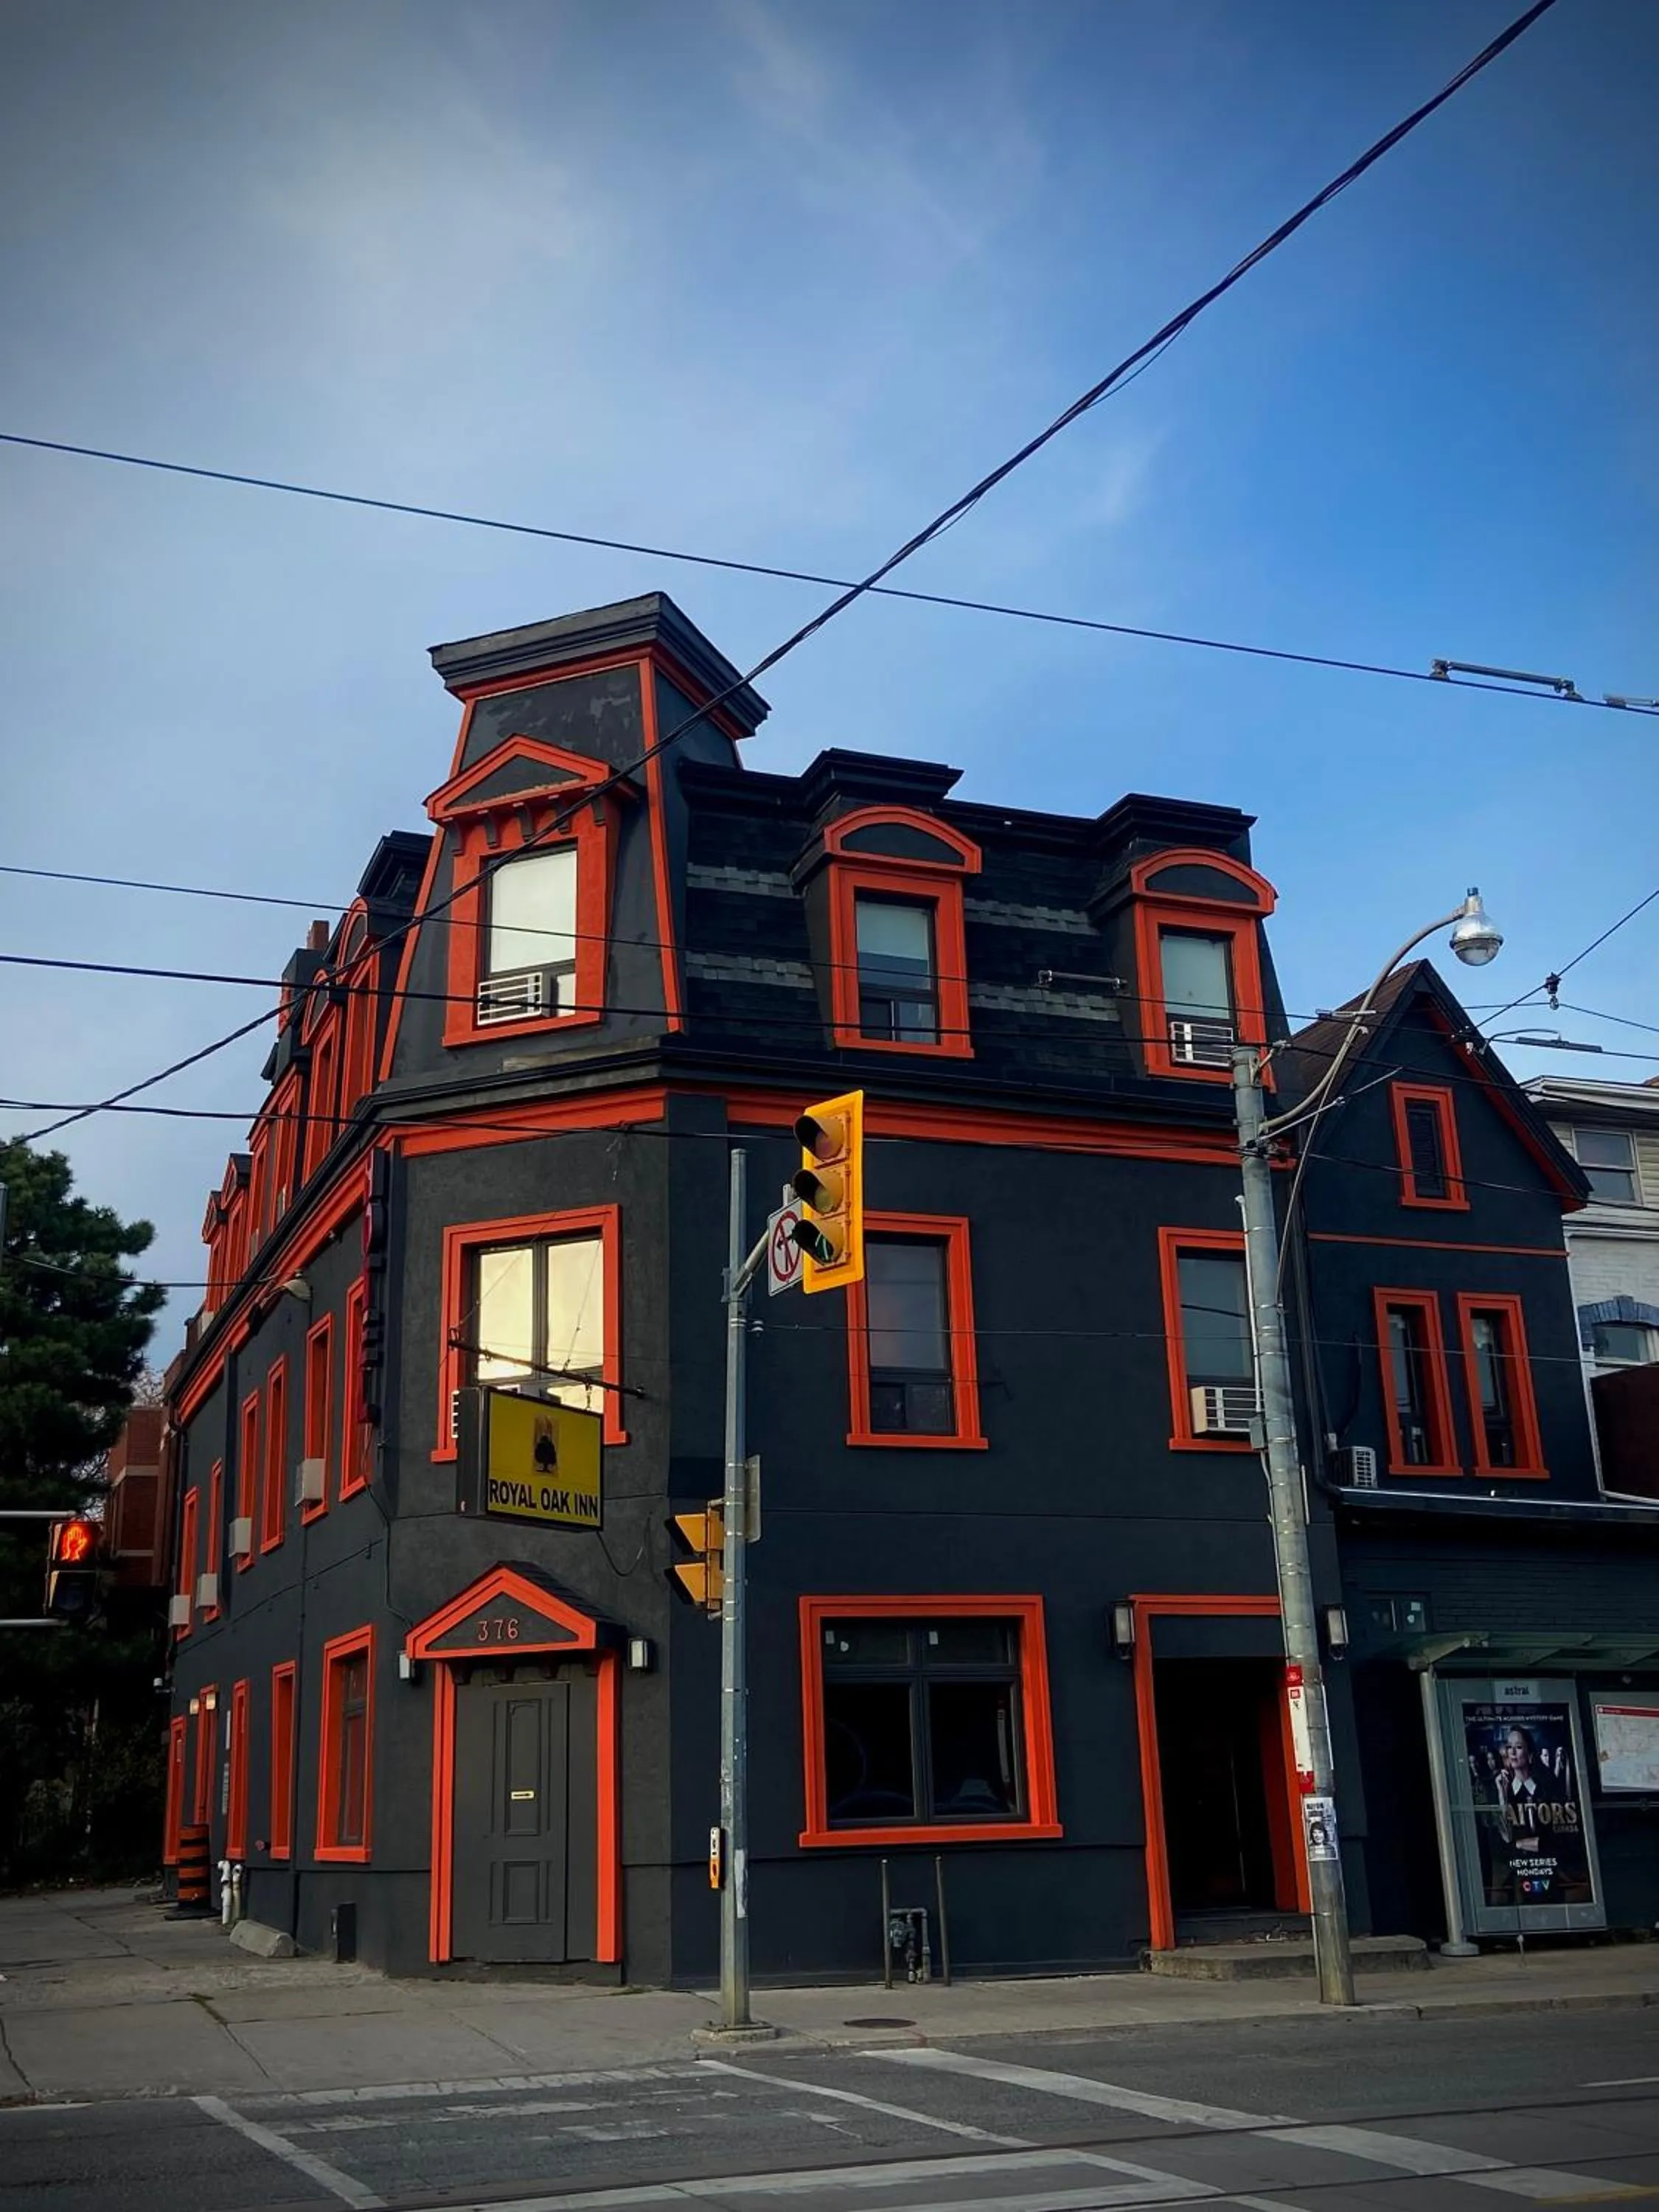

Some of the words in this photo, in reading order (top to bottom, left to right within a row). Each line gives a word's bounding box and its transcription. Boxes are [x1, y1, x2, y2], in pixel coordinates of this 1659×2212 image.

[489, 1478, 537, 1509] ROYAL
[540, 1487, 571, 1514] OAK
[574, 1492, 598, 1519] INN
[477, 1617, 518, 1641] 376
[1506, 1802, 1577, 1826] AITORS
[1509, 1859, 1528, 1867] NEW
[1529, 1858, 1557, 1866] SERIES
[1523, 1880, 1550, 1891] CTV
